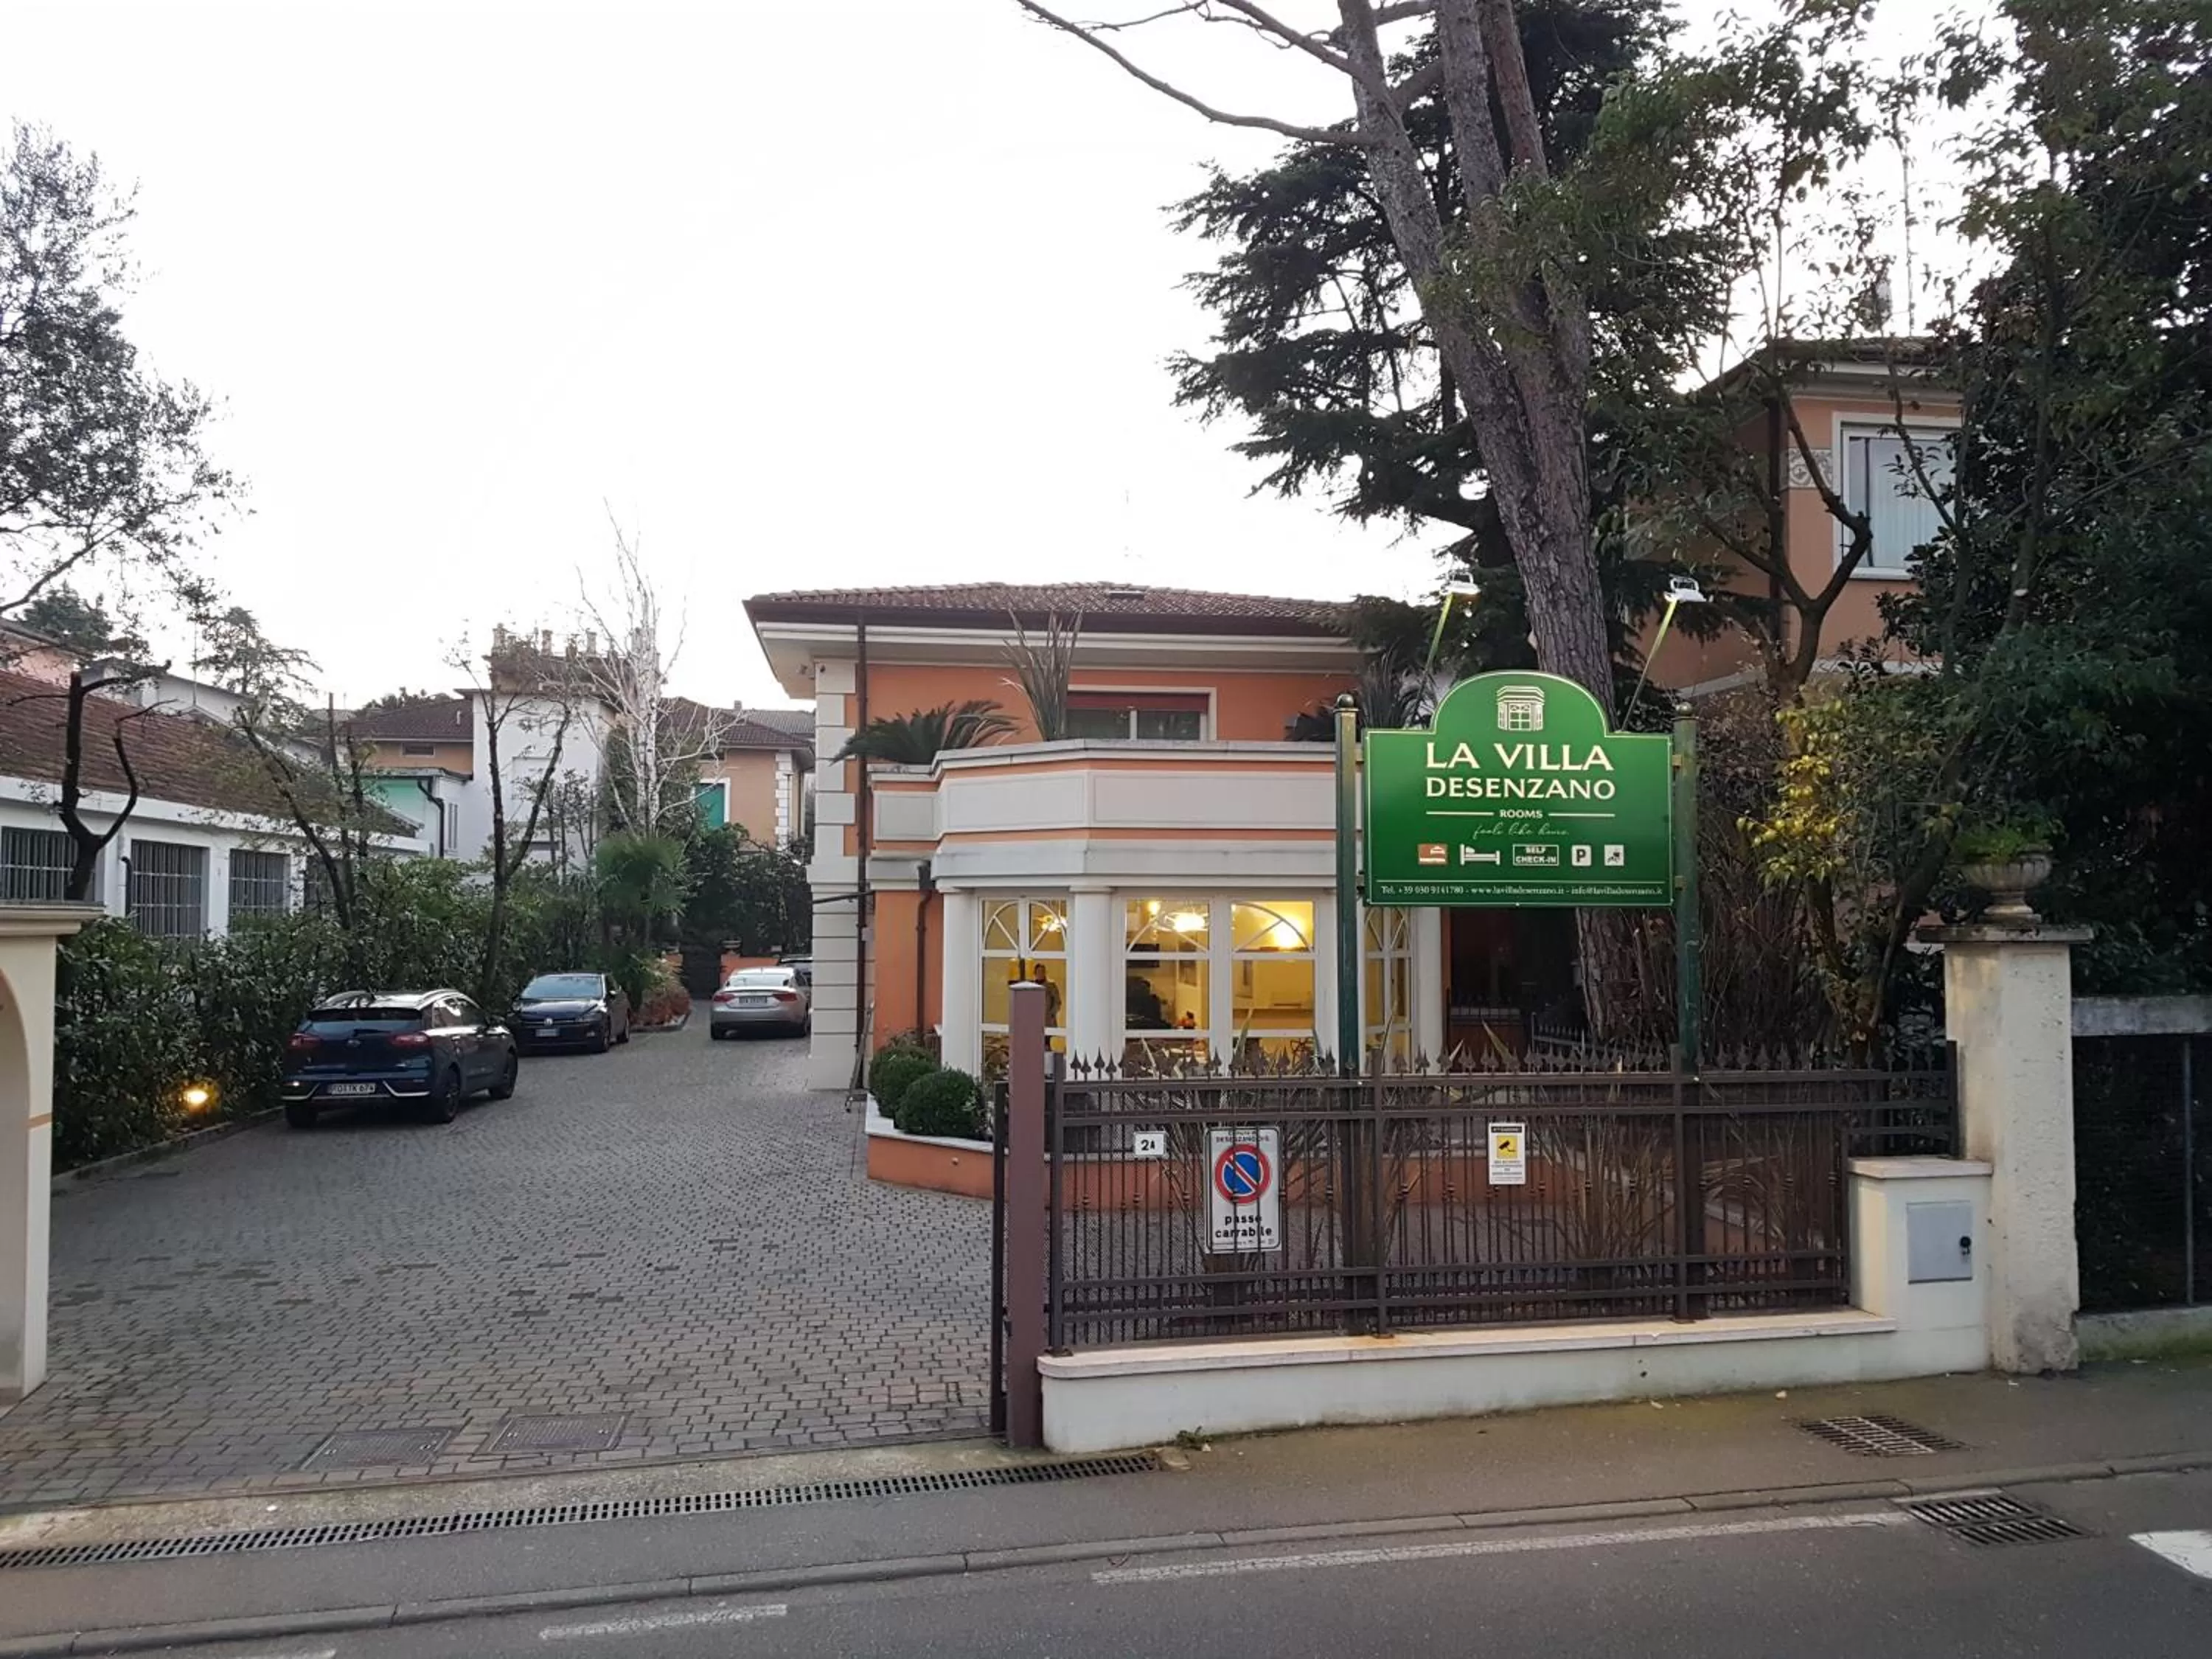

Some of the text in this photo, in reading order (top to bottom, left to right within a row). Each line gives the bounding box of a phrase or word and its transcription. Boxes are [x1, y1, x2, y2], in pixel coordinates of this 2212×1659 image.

[1426, 742, 1614, 771] LA VILLA
[1426, 776, 1615, 800] DESENZANO
[1499, 810, 1543, 818] ROOMS
[1515, 855, 1557, 864] CHECK-IN
